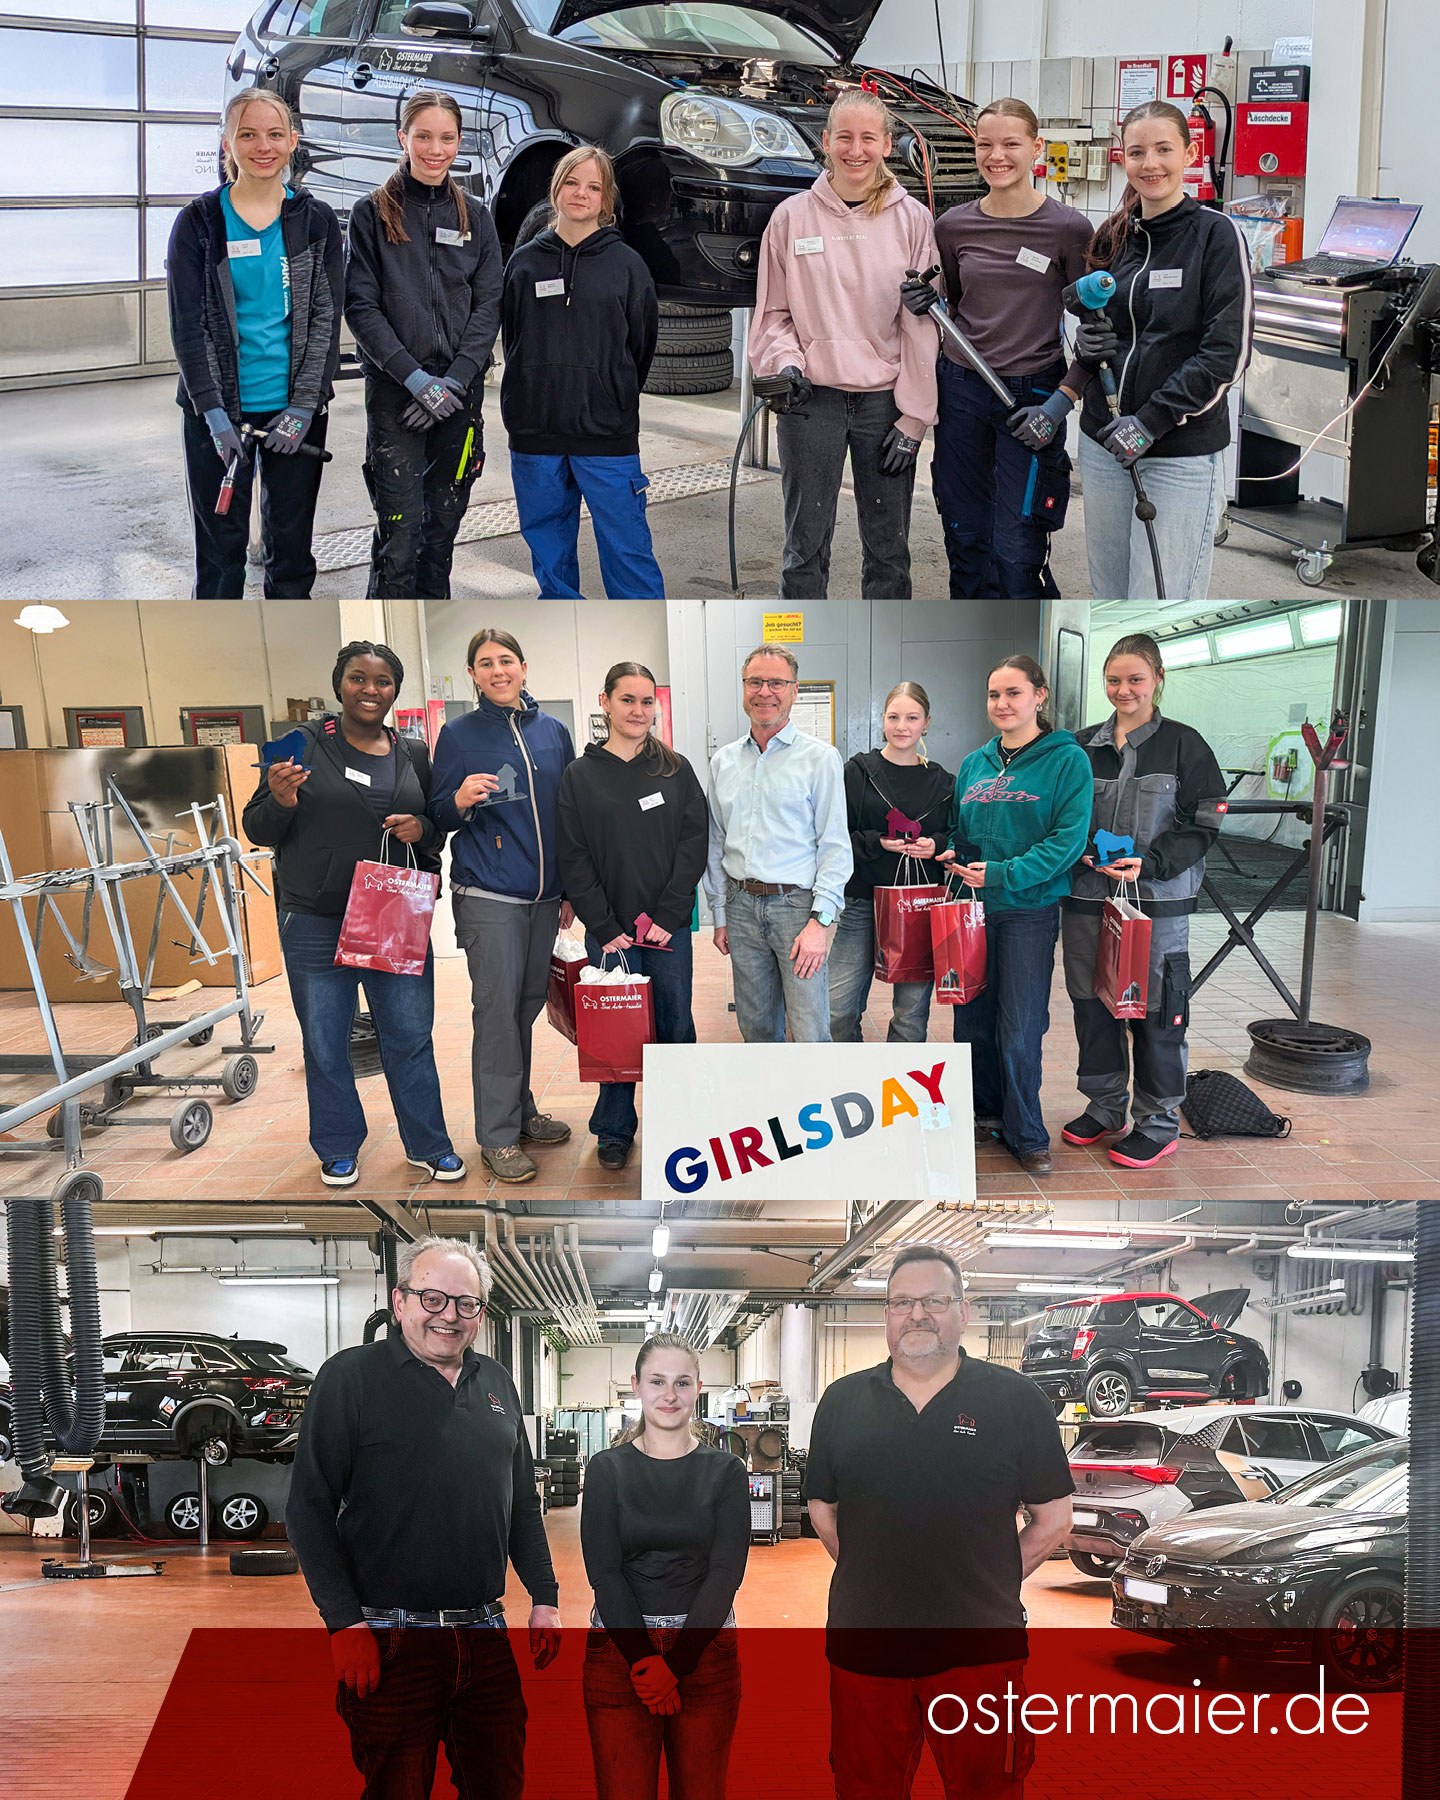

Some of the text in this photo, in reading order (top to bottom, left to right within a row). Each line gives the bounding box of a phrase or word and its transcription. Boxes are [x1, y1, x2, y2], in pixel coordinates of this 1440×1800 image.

[396, 51, 434, 62] OSTERMAIER
[372, 74, 425, 91] AUSBILDUNG
[1249, 113, 1289, 123] Löschdecke
[776, 621, 802, 629] gesucht?
[387, 877, 432, 891] OSTERMAIER
[599, 994, 642, 1003] OSTERMAIER
[664, 1061, 946, 1194] GIRLSDAY
